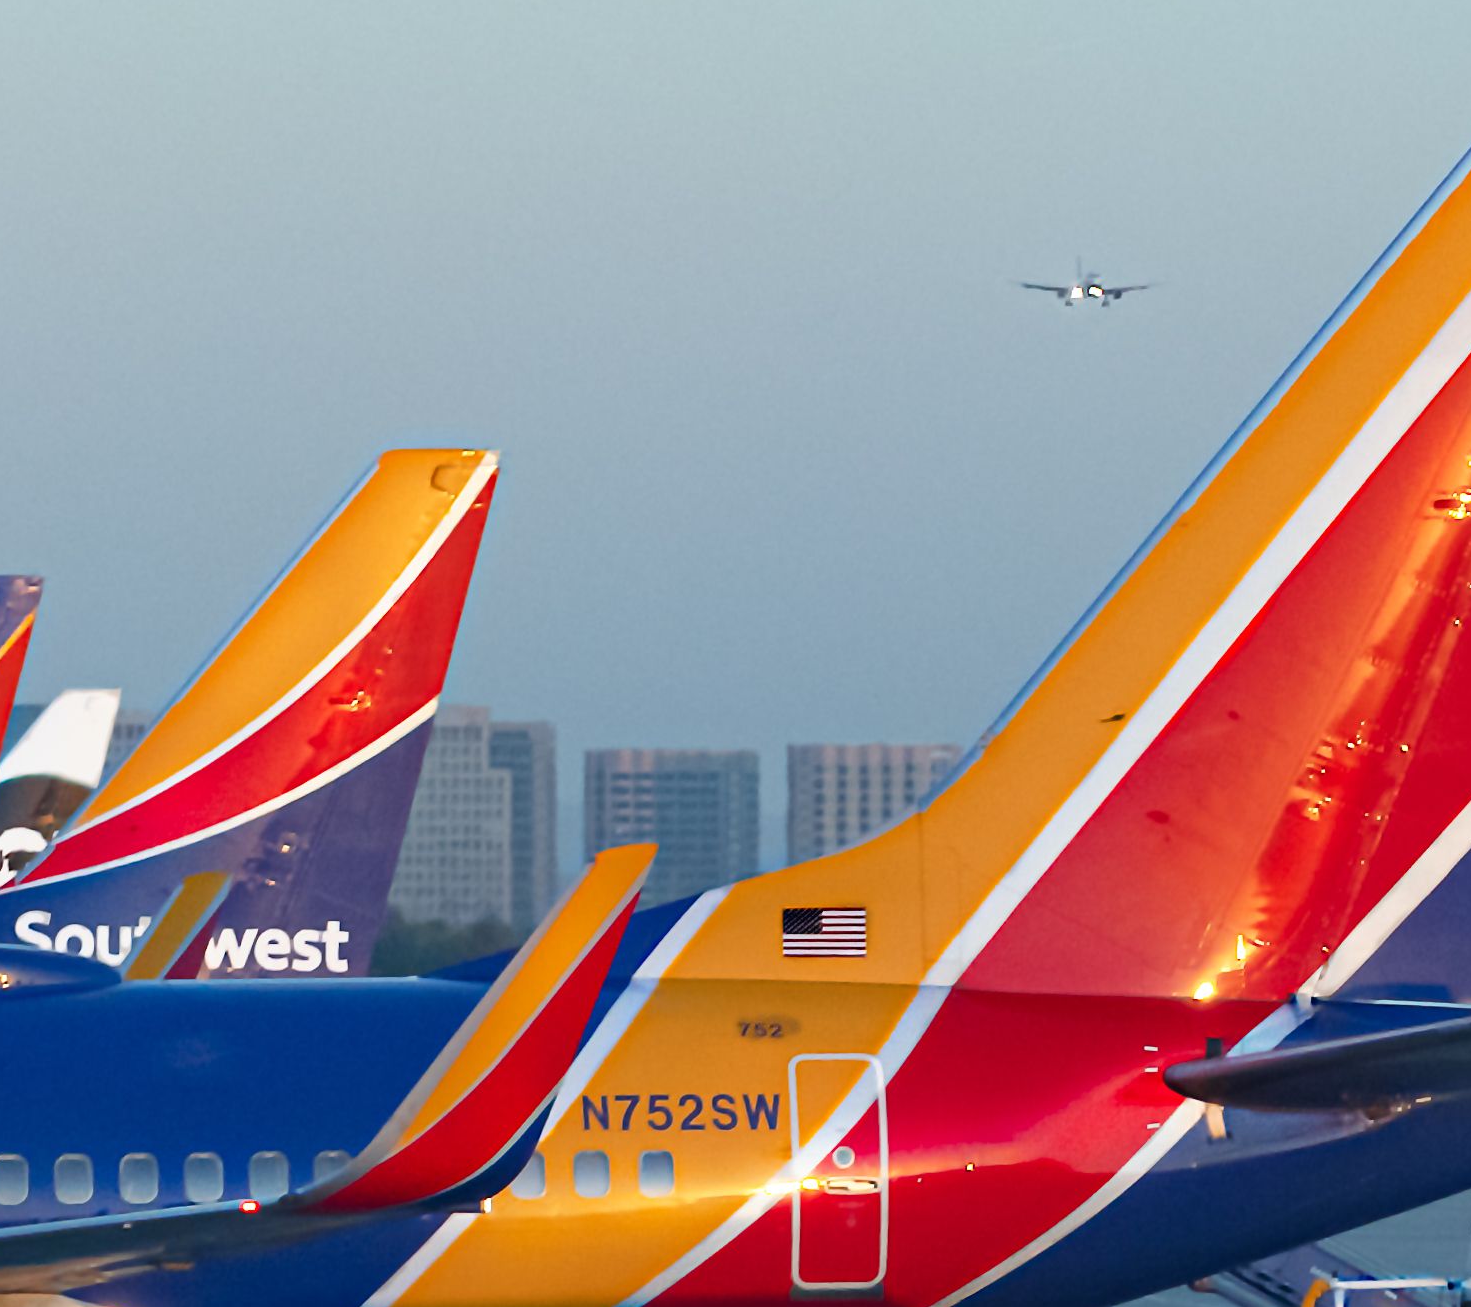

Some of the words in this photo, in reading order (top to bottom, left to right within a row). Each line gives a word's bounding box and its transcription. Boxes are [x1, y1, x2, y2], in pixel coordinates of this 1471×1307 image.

[14, 909, 349, 973] Souwest
[739, 1021, 784, 1038] 752
[582, 1094, 780, 1131] N752SW
